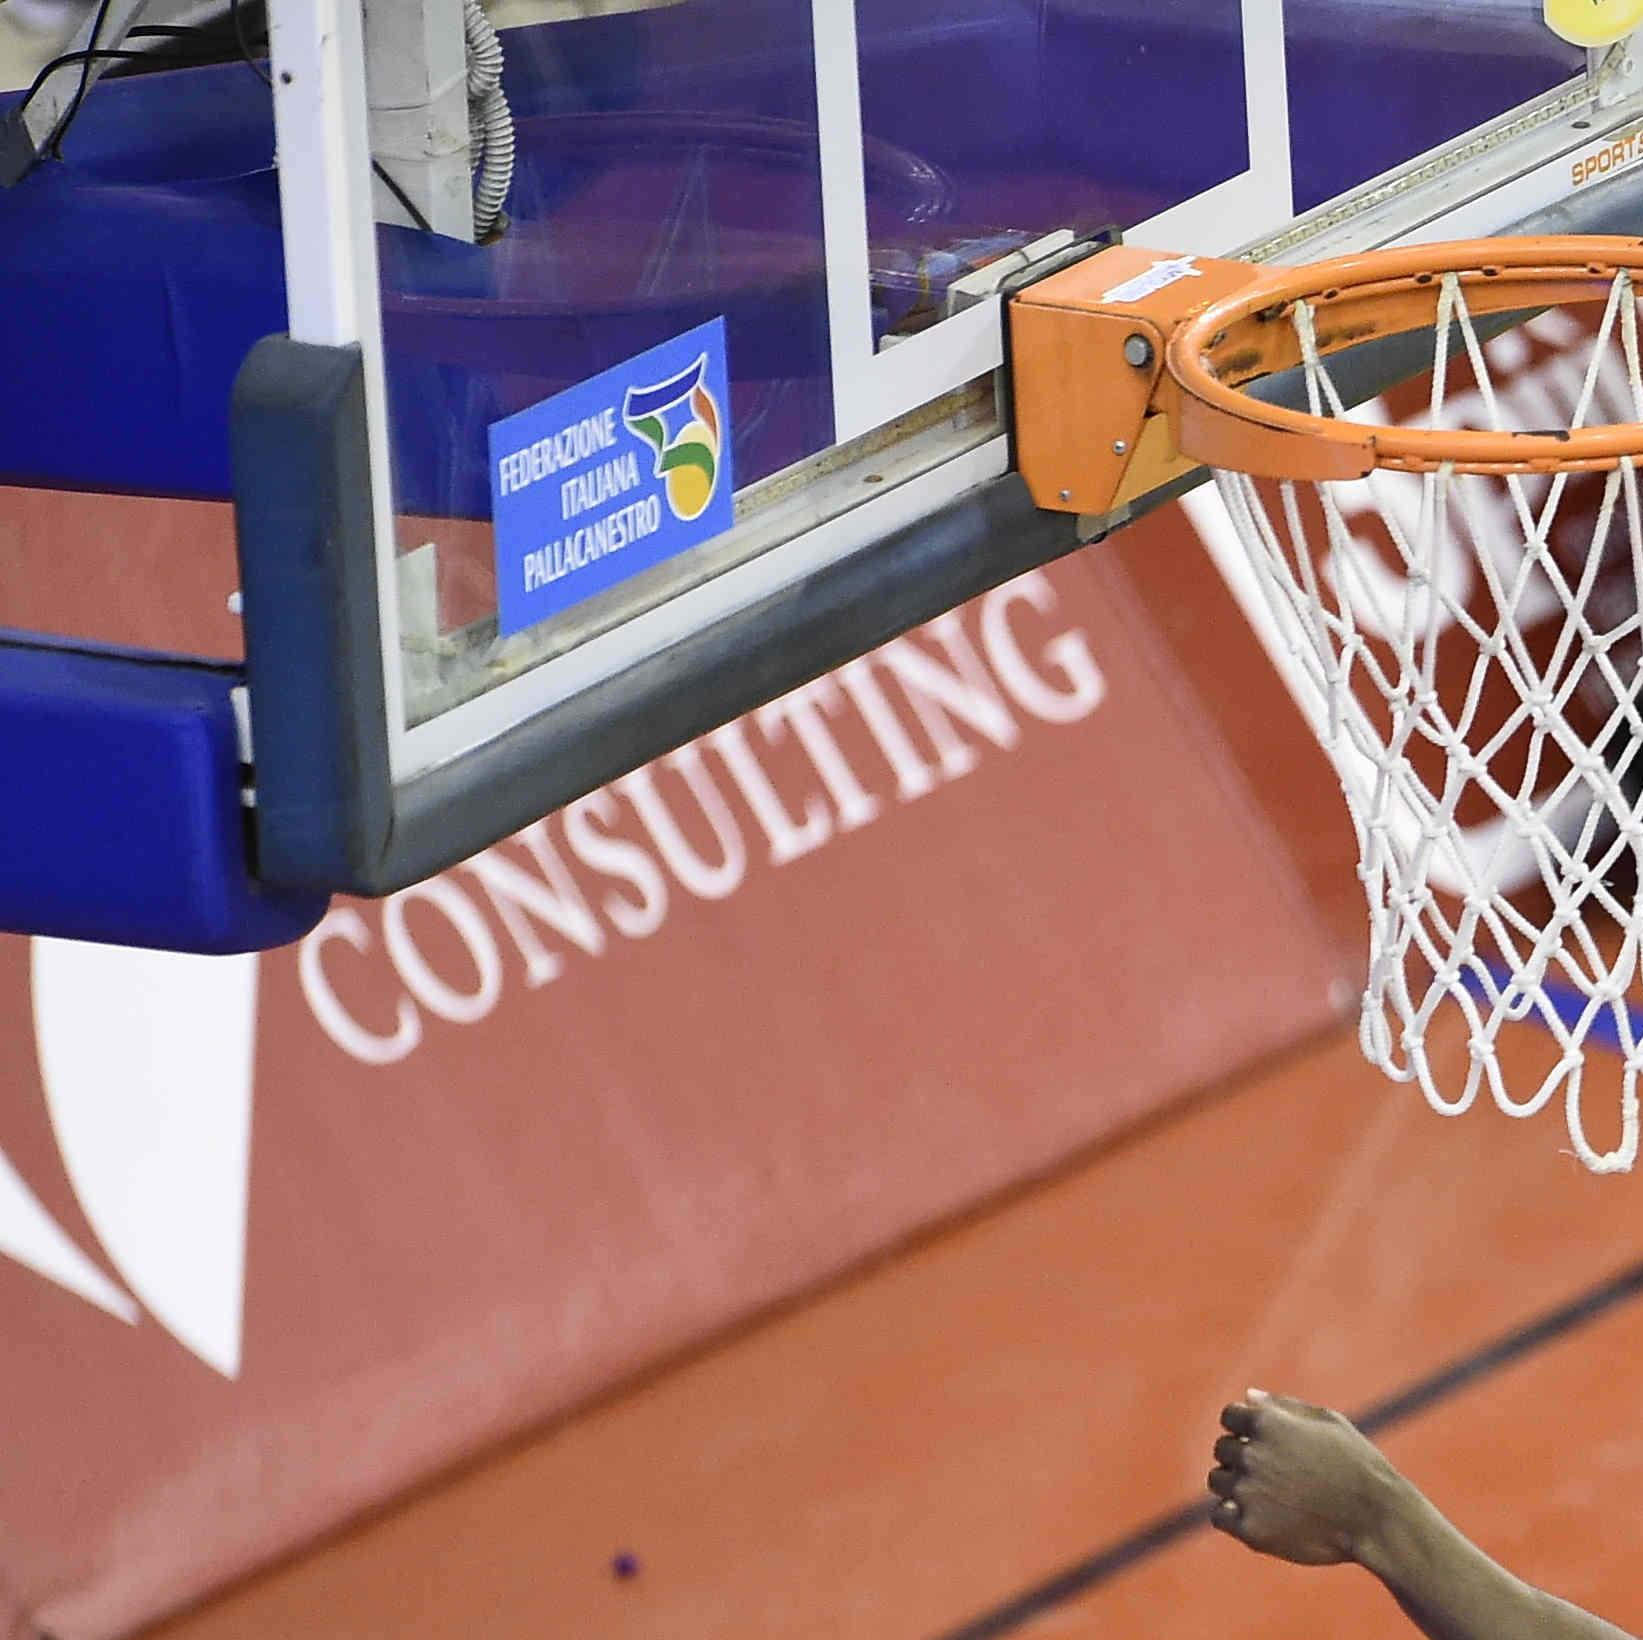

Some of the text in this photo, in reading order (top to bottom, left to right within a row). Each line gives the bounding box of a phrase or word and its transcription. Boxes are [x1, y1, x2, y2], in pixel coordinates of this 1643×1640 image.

[498, 406, 618, 497] FEDERAZIONE
[560, 451, 641, 521] ITALIANA
[523, 493, 661, 593] PALLACANESTRO
[298, 571, 1105, 1065] CONSULTING
